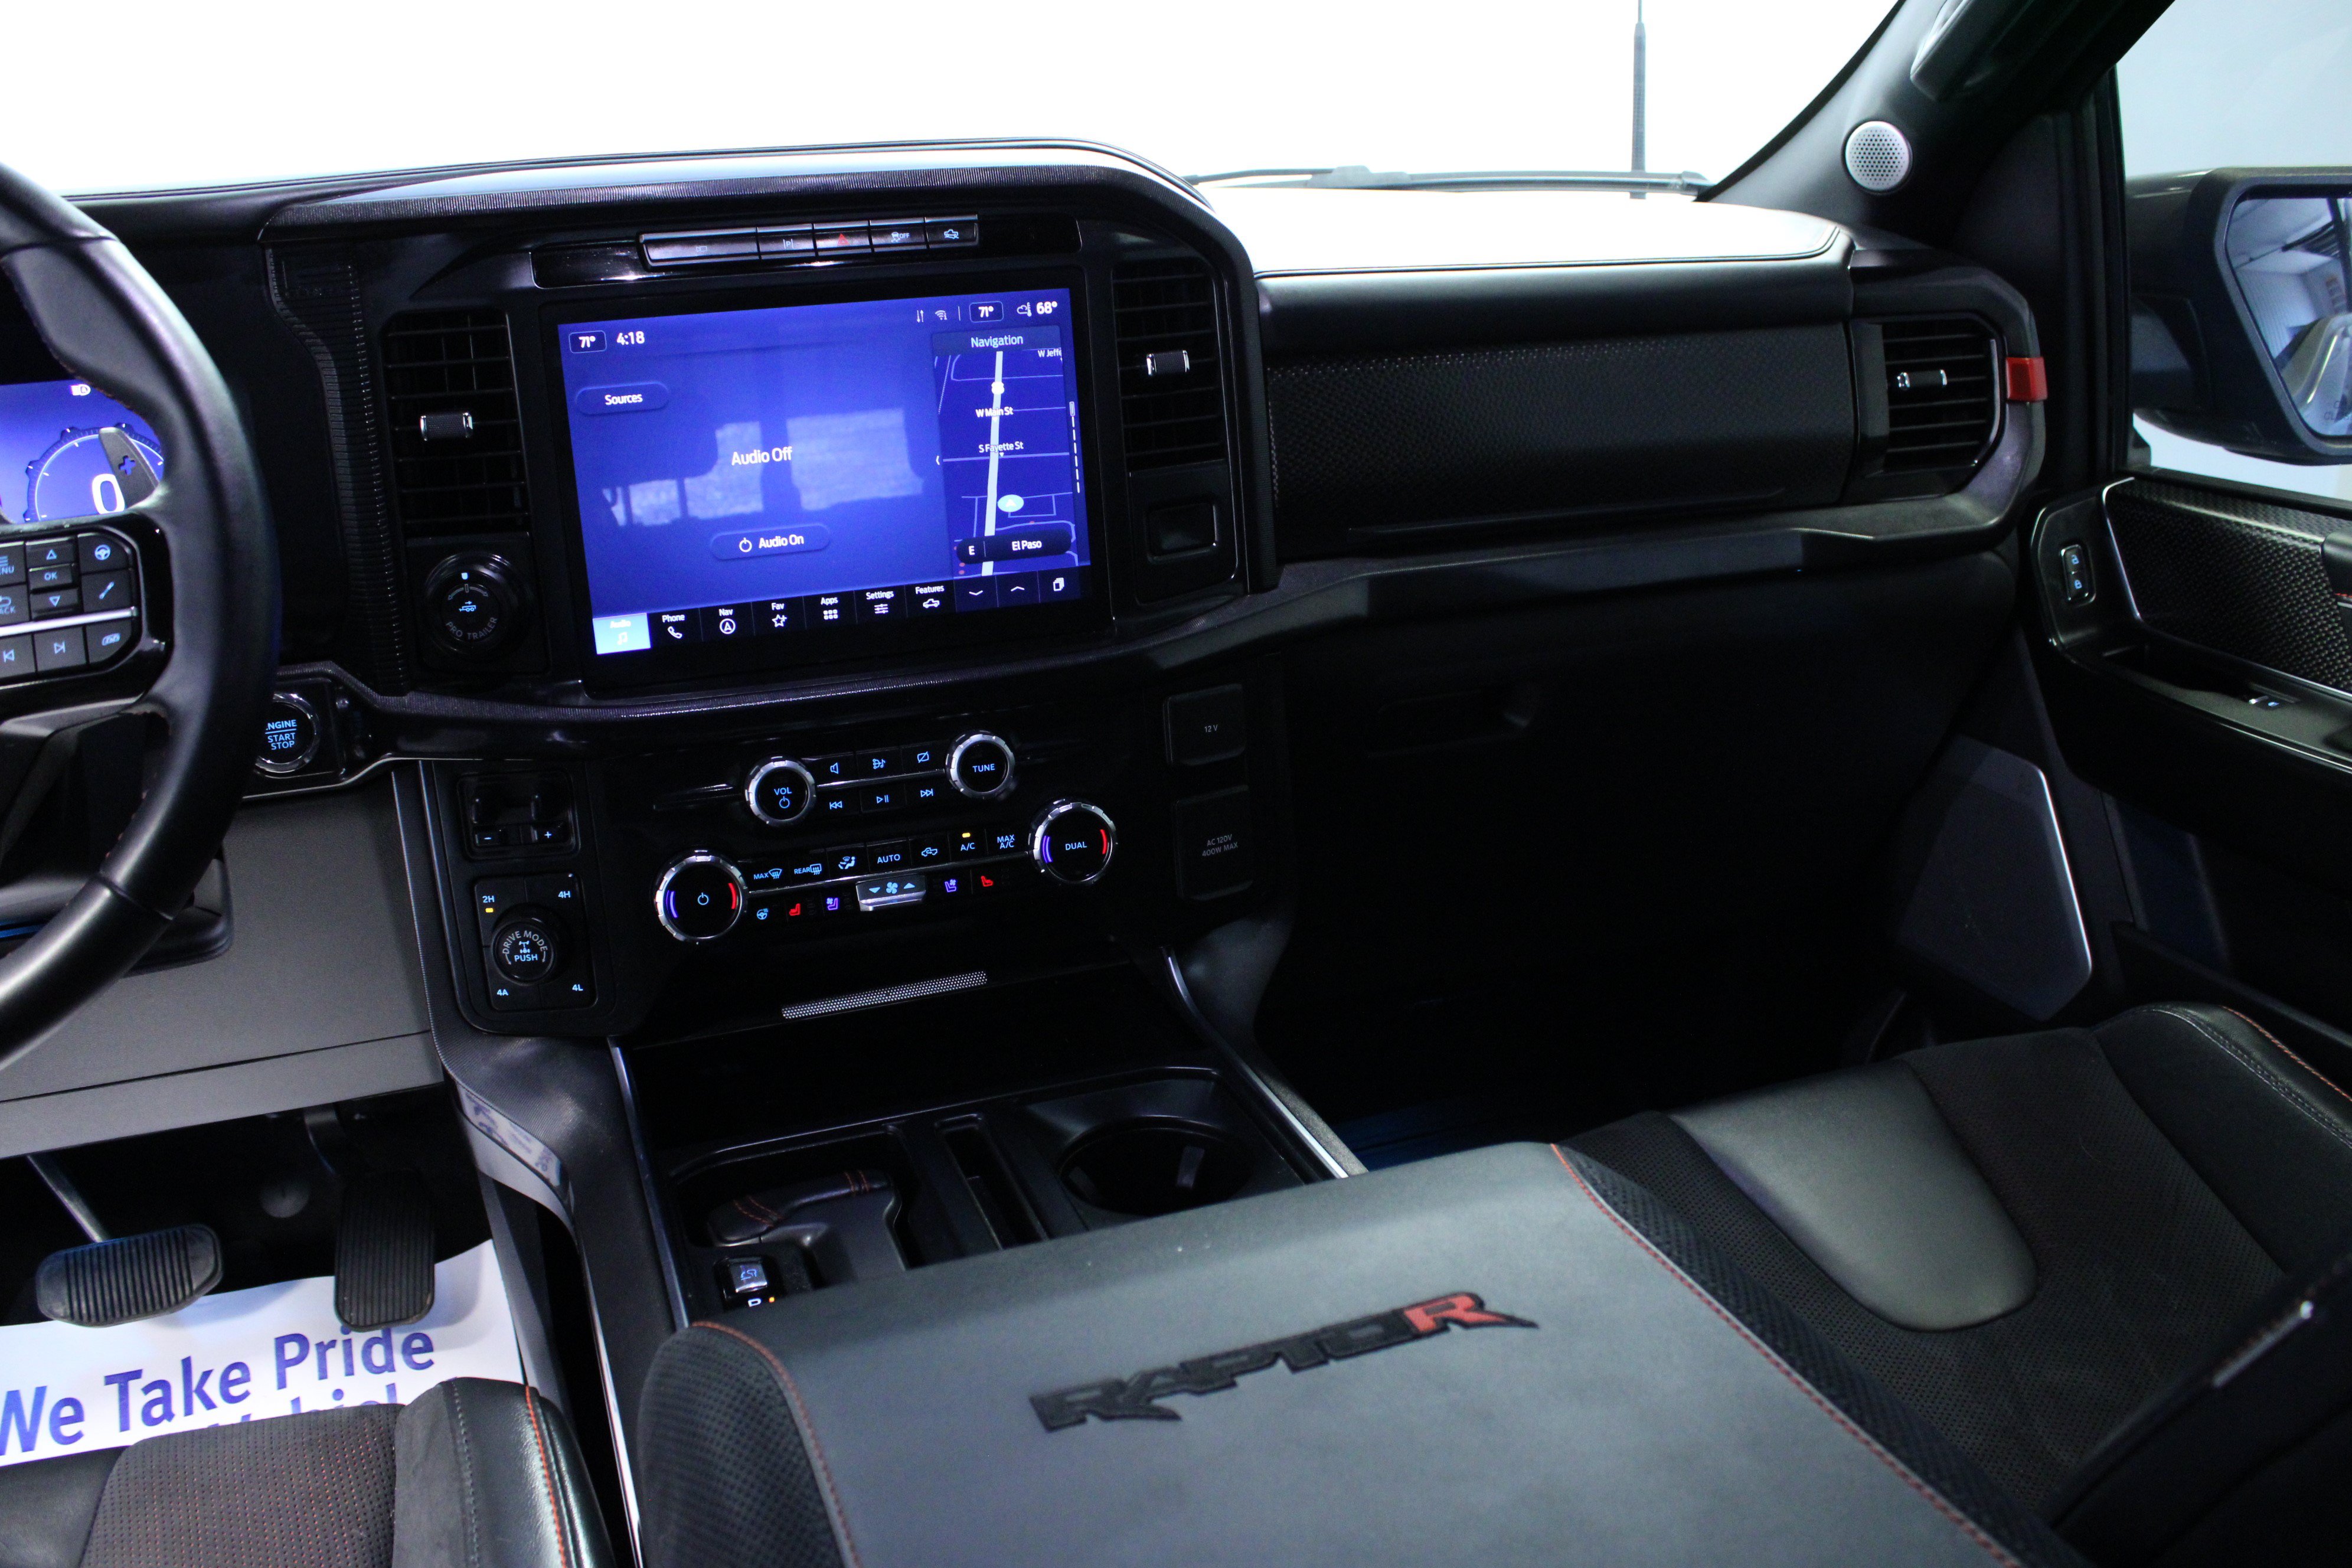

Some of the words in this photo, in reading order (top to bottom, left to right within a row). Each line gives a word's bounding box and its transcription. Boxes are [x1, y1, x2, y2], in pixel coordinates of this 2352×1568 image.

[1036, 301, 1058, 315] 68°
[616, 331, 645, 345] 4:18
[971, 334, 1024, 349] Navigation
[605, 393, 643, 406] Sources
[975, 409, 984, 417] W
[985, 407, 1004, 416] Main
[1004, 406, 1014, 416] St
[978, 445, 984, 453] S
[985, 443, 1014, 453] Fayette
[1014, 441, 1024, 450] St
[731, 450, 770, 466] Audio
[772, 446, 793, 462] Off
[758, 535, 788, 549] Audio
[789, 534, 805, 546] On
[1011, 541, 1021, 551] El
[1022, 540, 1043, 550] Paso
[968, 545, 975, 556] E
[44, 571, 57, 581] OK
[915, 585, 945, 594] Features
[865, 591, 894, 600] Settings
[771, 602, 785, 610] Fav
[820, 597, 838, 605] Apps
[718, 608, 734, 617] Nav
[662, 613, 685, 623] Phone
[446, 622, 462, 637] PRO
[468, 617, 497, 639] TRAILER
[266, 719, 298, 731] NGINE
[267, 732, 296, 743] START
[271, 740, 295, 750] STOP
[972, 763, 996, 773] TUNE
[774, 786, 792, 796] VOL
[997, 834, 1015, 844] MAX
[1207, 838, 1216, 847] AC
[1217, 834, 1233, 844] 120V
[960, 842, 975, 851] A/C
[999, 841, 1014, 850] A/C
[1065, 841, 1087, 851] DUAL
[1202, 847, 1221, 857] 400W
[1224, 841, 1239, 851] MAX
[877, 854, 900, 864] AUTO
[793, 867, 810, 875] REAR
[482, 894, 495, 903] 2H
[558, 890, 571, 899] 4H
[502, 930, 521, 955] DRIVE
[523, 930, 548, 952] MODE
[514, 953, 538, 962] PUSH
[496, 988, 508, 997] 4A
[572, 984, 583, 992] 4L
[1029, 1291, 1540, 1433] RAPTOR
[0, 1386, 85, 1456] We
[104, 1355, 252, 1433] Take
[274, 1327, 435, 1390] Pride
